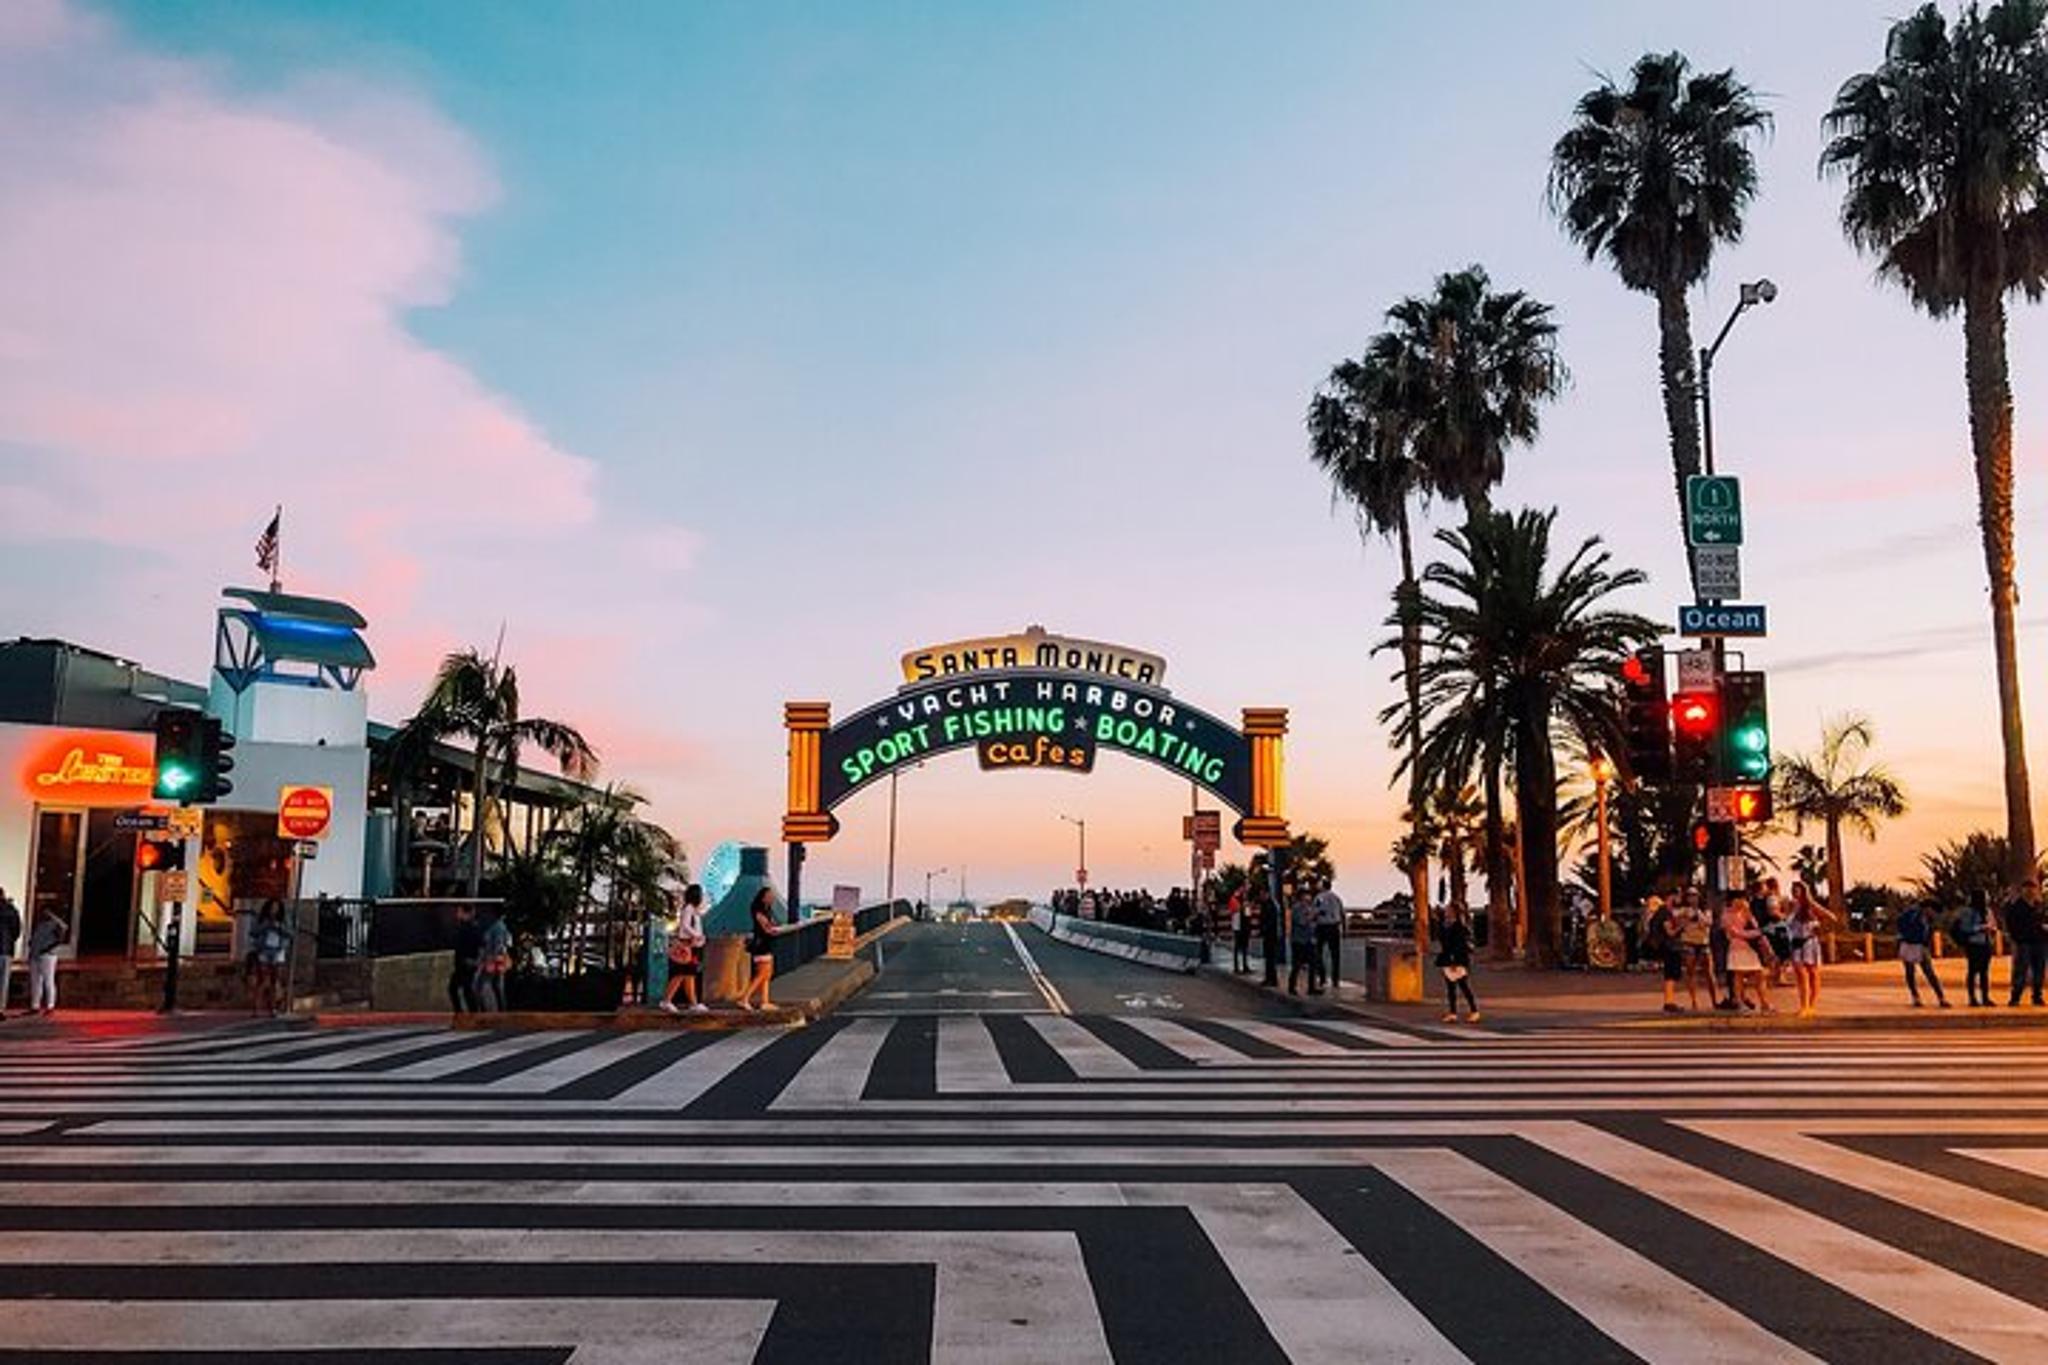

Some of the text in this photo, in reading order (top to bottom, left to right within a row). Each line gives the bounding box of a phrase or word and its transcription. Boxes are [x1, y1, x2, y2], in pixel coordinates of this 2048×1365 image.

[1711, 488, 1719, 504] 1
[1693, 513, 1738, 526] NORTH
[1685, 609, 1760, 627] Ocean
[914, 642, 1156, 683] SANTA MONICA
[898, 681, 1177, 725] YACHT HARBOR
[841, 707, 1225, 784] SPORT FISHING BOATING
